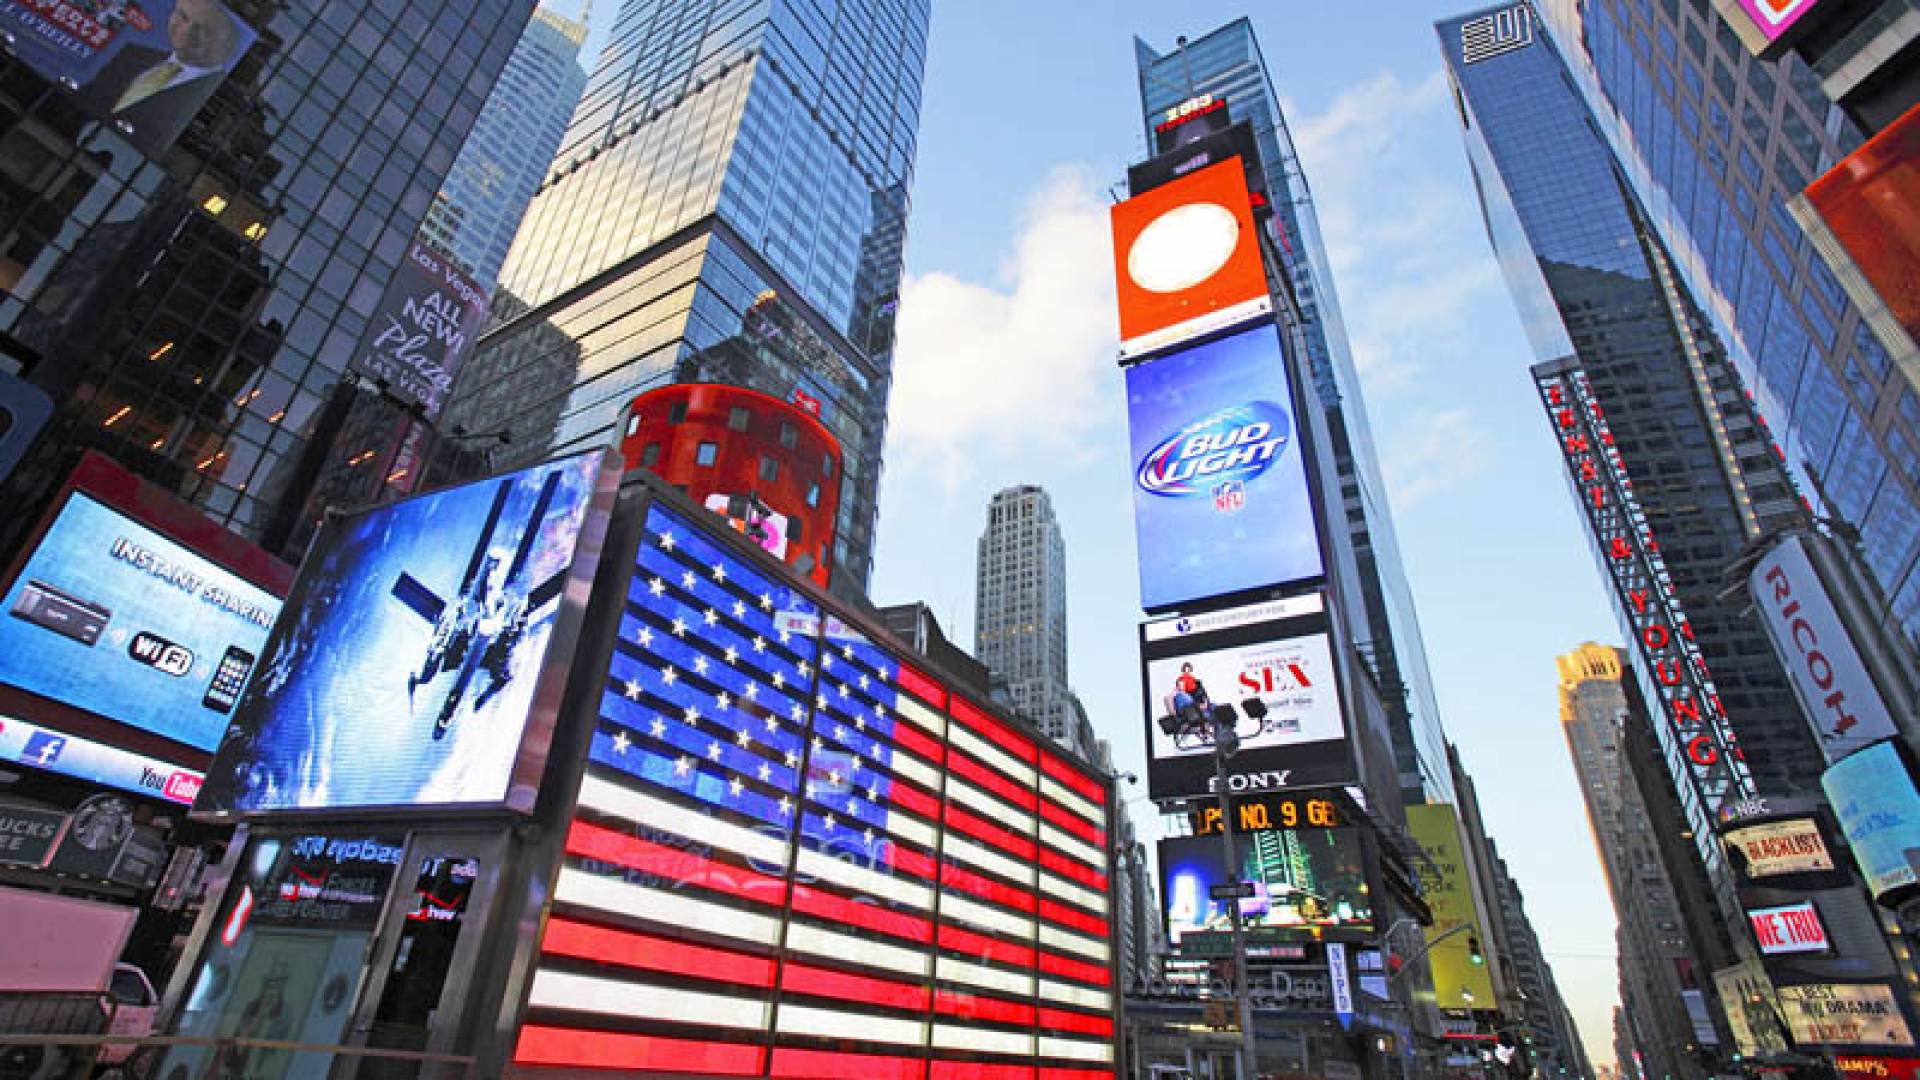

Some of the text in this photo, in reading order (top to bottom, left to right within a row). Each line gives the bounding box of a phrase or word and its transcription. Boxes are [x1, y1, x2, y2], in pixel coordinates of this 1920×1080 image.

[423, 293, 461, 328] ALL
[1163, 436, 1287, 481] LIGHT
[1181, 422, 1271, 460] BUD
[1216, 492, 1244, 513] NFL
[110, 535, 203, 594] INSTANT
[1766, 565, 1858, 735] RICOH
[1630, 589, 1717, 765] YOUNG
[1282, 801, 1297, 826] 9
